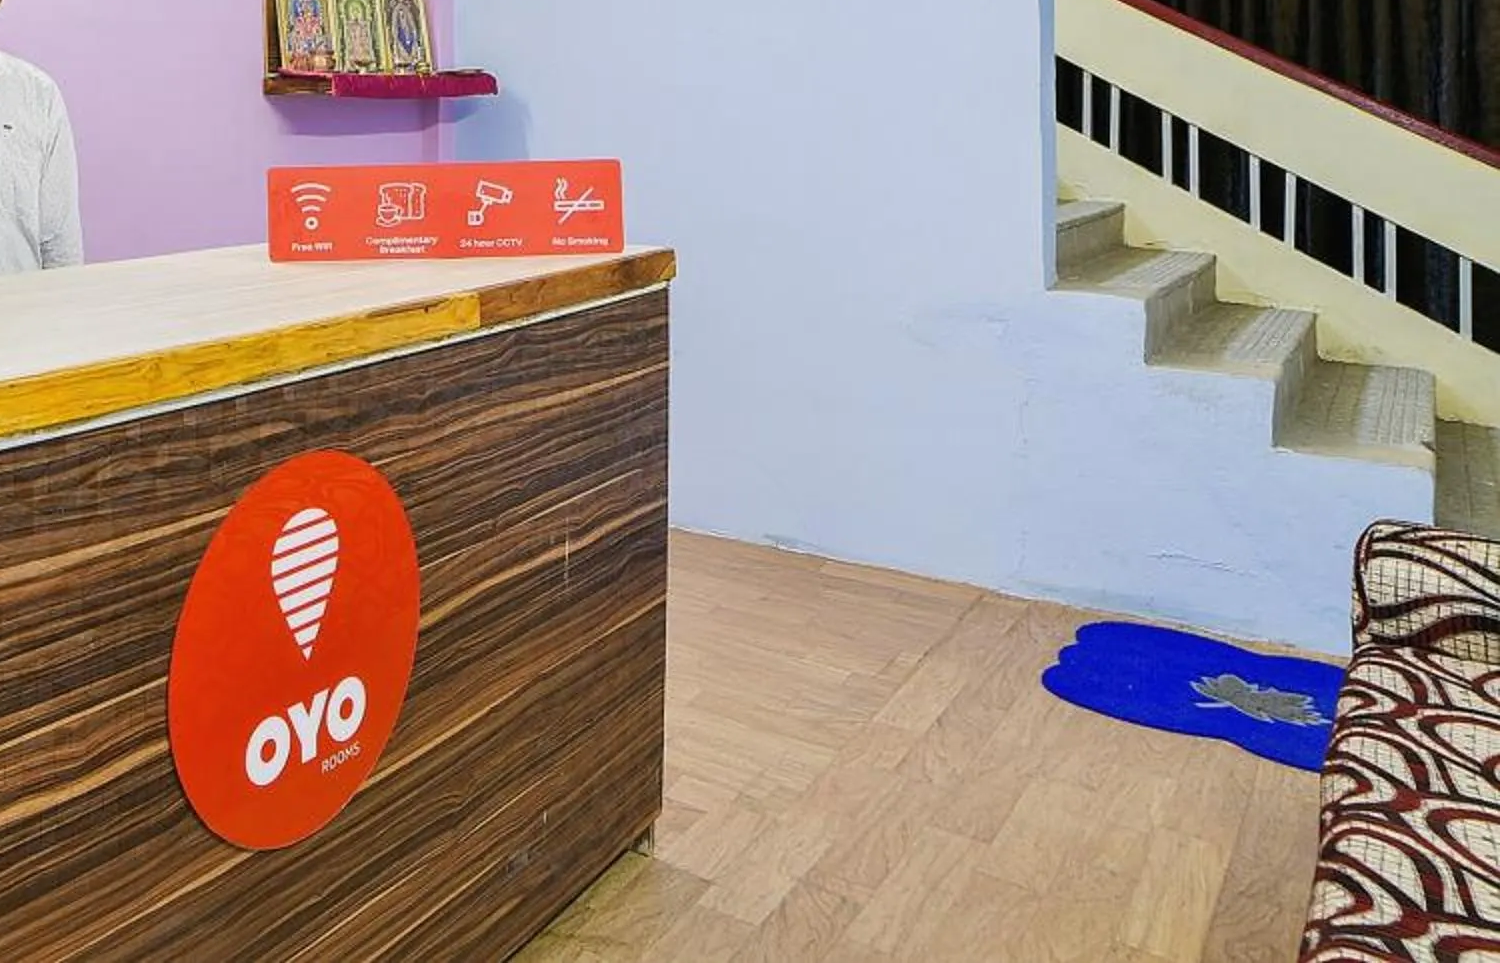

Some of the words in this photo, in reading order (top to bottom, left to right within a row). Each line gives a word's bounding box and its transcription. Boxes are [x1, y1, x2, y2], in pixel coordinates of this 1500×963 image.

[291, 242, 313, 252] Free
[459, 238, 472, 248] 24
[473, 238, 495, 247] hour
[496, 237, 523, 247] CCTV
[551, 236, 566, 246] No
[567, 236, 610, 247] Smoking
[244, 675, 367, 787] OYO
[320, 740, 361, 774] ROOMS
